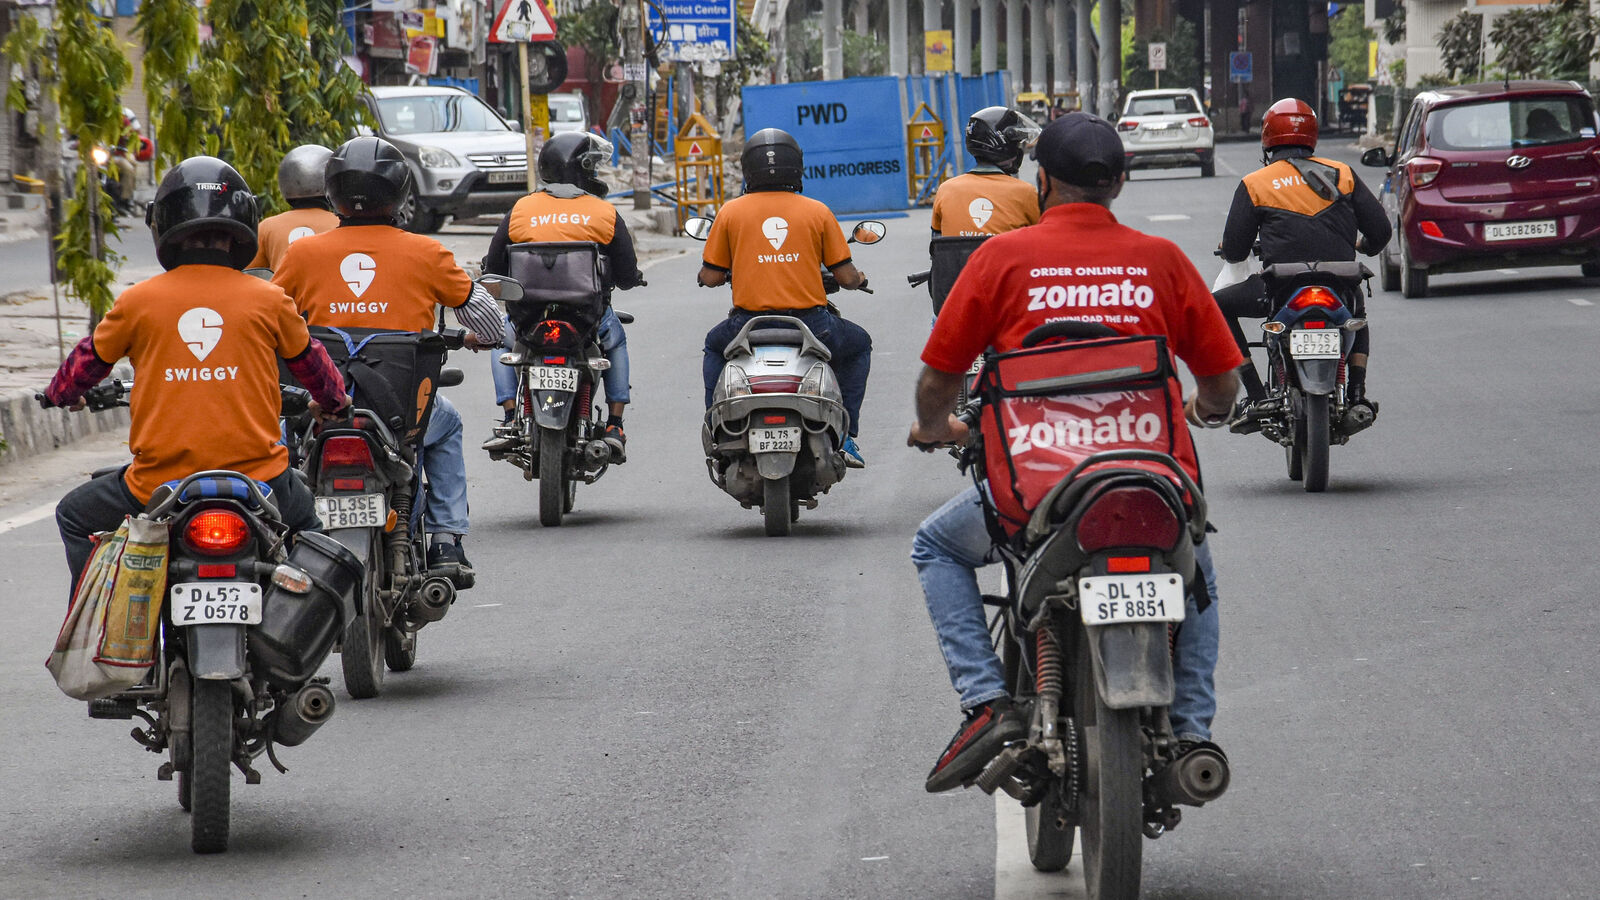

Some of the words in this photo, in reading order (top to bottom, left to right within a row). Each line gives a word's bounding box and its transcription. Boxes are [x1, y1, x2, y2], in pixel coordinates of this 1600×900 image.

[663, 5, 693, 15] istrict
[694, 4, 728, 15] Centre
[797, 103, 847, 126] PWD
[829, 160, 901, 179] PROGRESS
[195, 181, 230, 195] TRIMAX
[1272, 175, 1308, 190] SWI
[530, 212, 591, 228] SWIGGY
[757, 252, 800, 264] SWIGGY
[1030, 267, 1073, 278] ORDER
[1075, 266, 1124, 277] ONLINE
[1126, 266, 1148, 276] ON
[1027, 278, 1154, 312] zomato
[329, 301, 389, 314] SWIGGY
[1104, 315, 1122, 323] THE
[1123, 315, 1140, 324] APP
[164, 366, 239, 382] SWIGGY
[539, 368, 574, 380] DL5SA
[539, 379, 574, 391] K0964
[1008, 407, 1162, 457] zomato
[760, 442, 770, 450] BF
[328, 496, 377, 513] DL3SE
[328, 511, 378, 528] F8035
[1108, 583, 1130, 599] DL
[1136, 581, 1156, 598] 13
[183, 605, 196, 621] Z
[204, 604, 249, 621] 0578
[1098, 602, 1119, 620] SF
[1125, 599, 1166, 618] 8851
